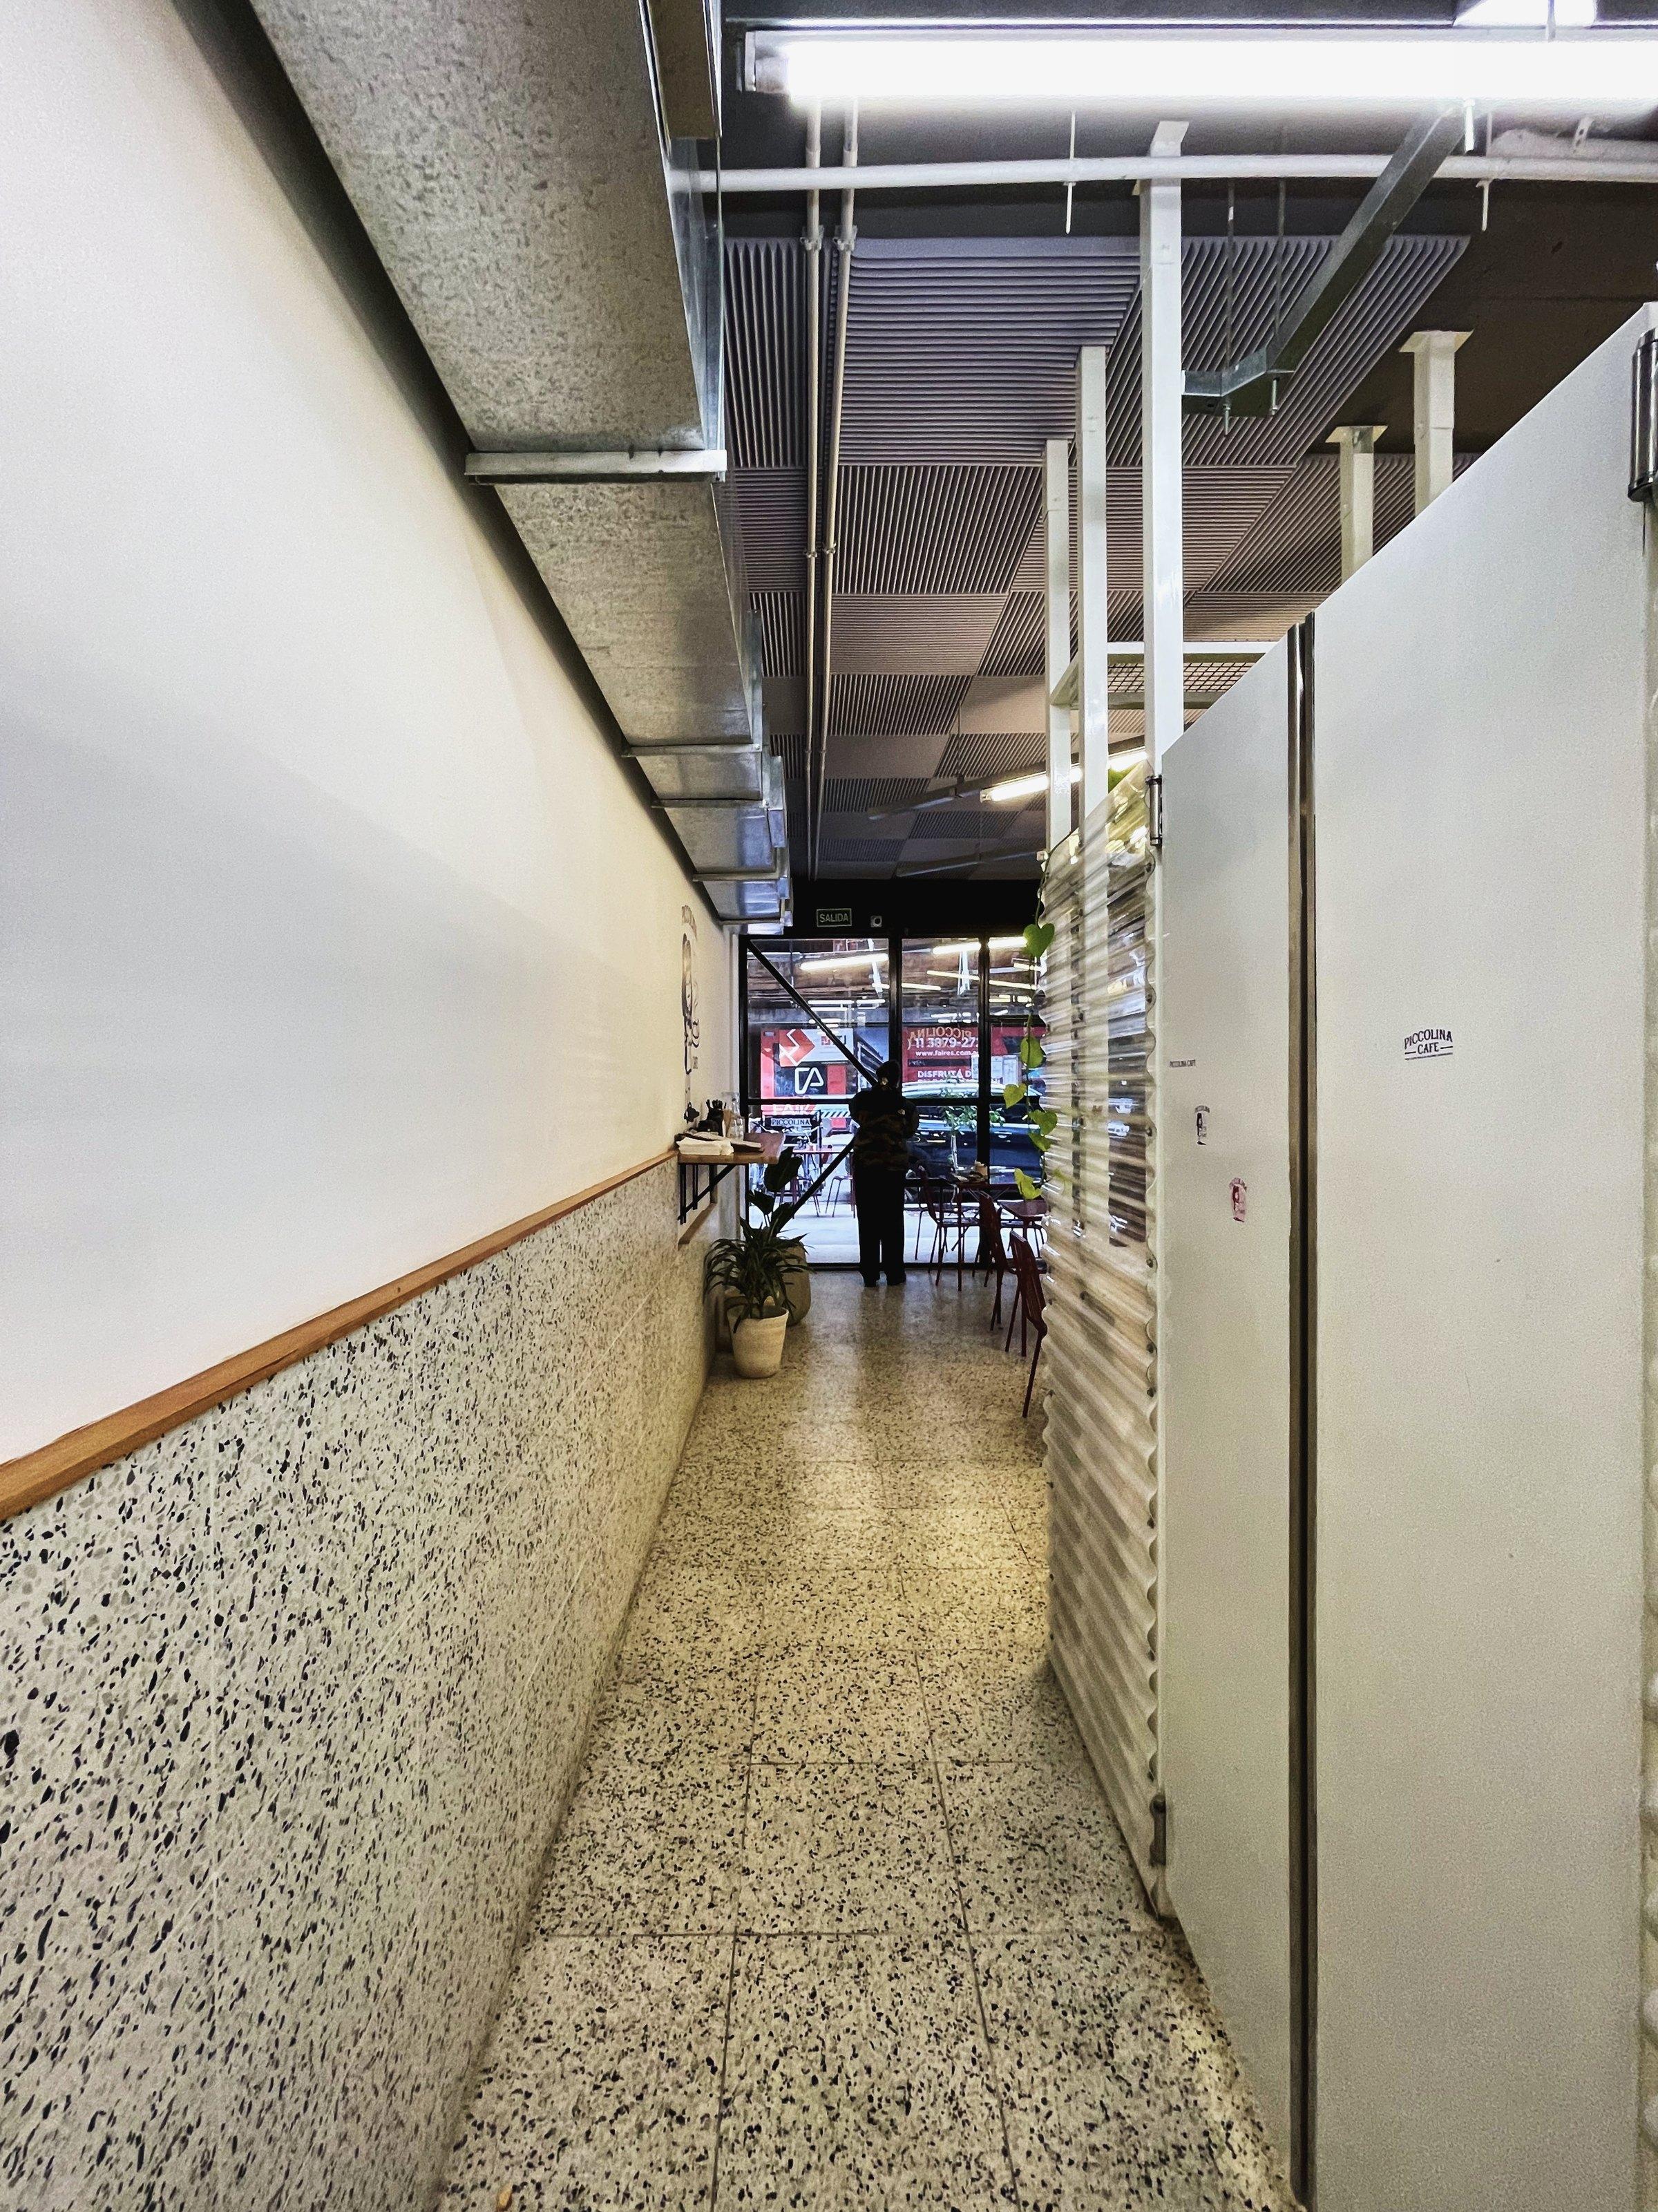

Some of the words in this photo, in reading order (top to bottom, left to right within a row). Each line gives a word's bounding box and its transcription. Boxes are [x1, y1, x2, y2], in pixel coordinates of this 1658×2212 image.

[819, 913, 849, 923] SALIDA
[1404, 1029, 1453, 1050] PICCOLINA
[1418, 1041, 1439, 1055] CAFE
